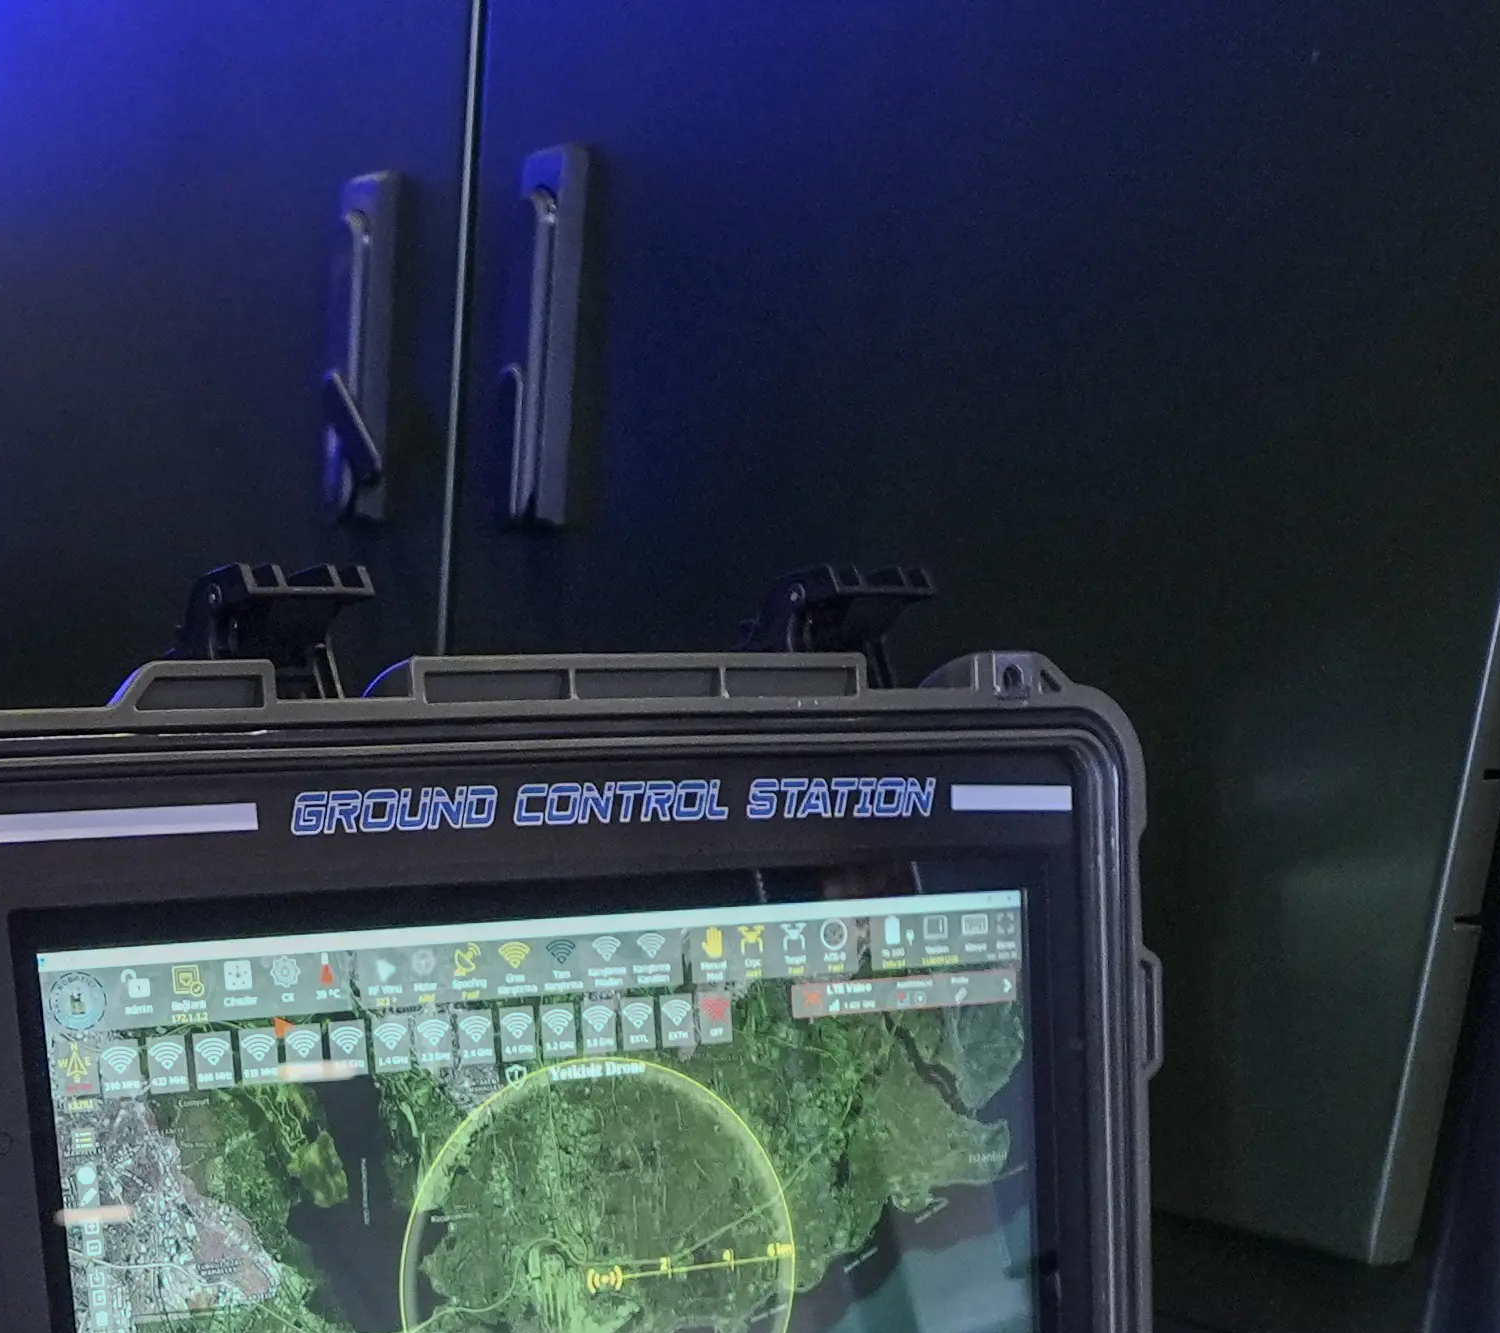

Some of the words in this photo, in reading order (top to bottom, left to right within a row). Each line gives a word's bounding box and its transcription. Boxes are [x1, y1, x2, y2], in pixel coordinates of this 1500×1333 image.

[291, 785, 498, 836] GROUND
[514, 779, 728, 826] CONTROL
[746, 776, 936, 820] STATION
[125, 1004, 153, 1016] admin
[606, 1061, 646, 1077] Drone
